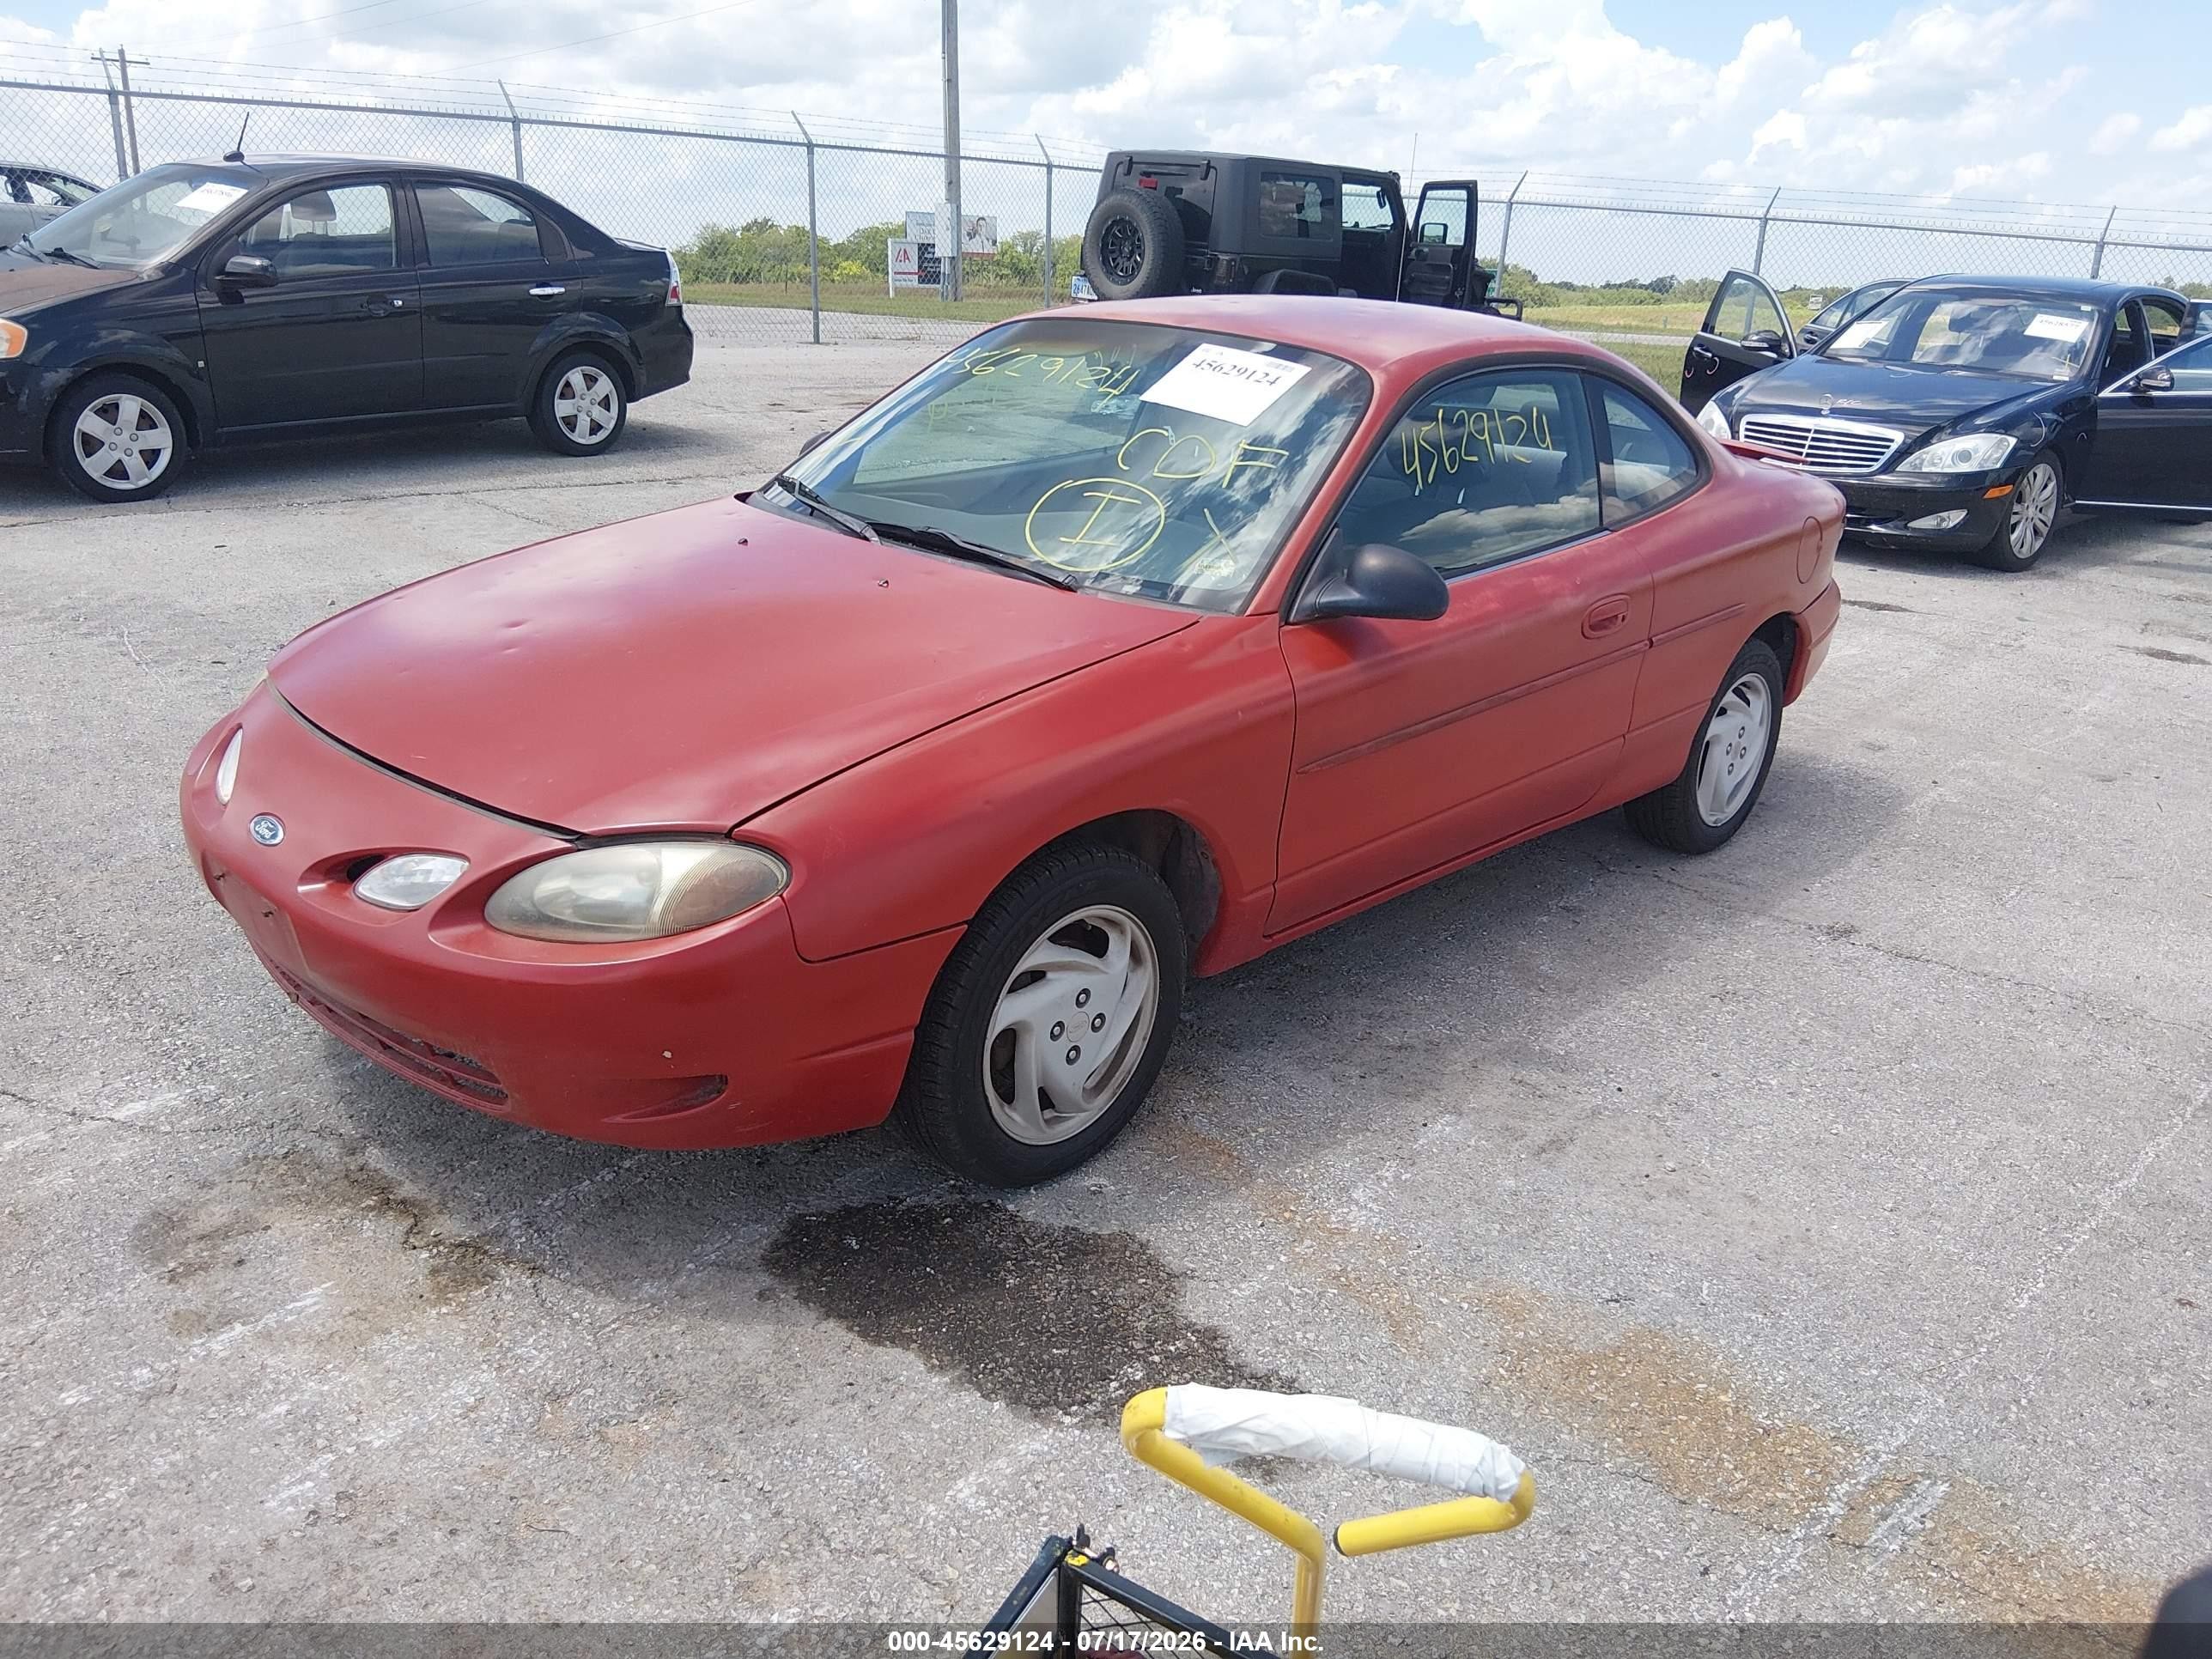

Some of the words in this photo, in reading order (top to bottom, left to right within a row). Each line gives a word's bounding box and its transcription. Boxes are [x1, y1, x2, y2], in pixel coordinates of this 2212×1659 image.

[946, 347, 1140, 412] 45629124
[1191, 359, 1282, 386] 45629124
[1401, 405, 1553, 490] 45629124
[254, 819, 276, 839] Ford
